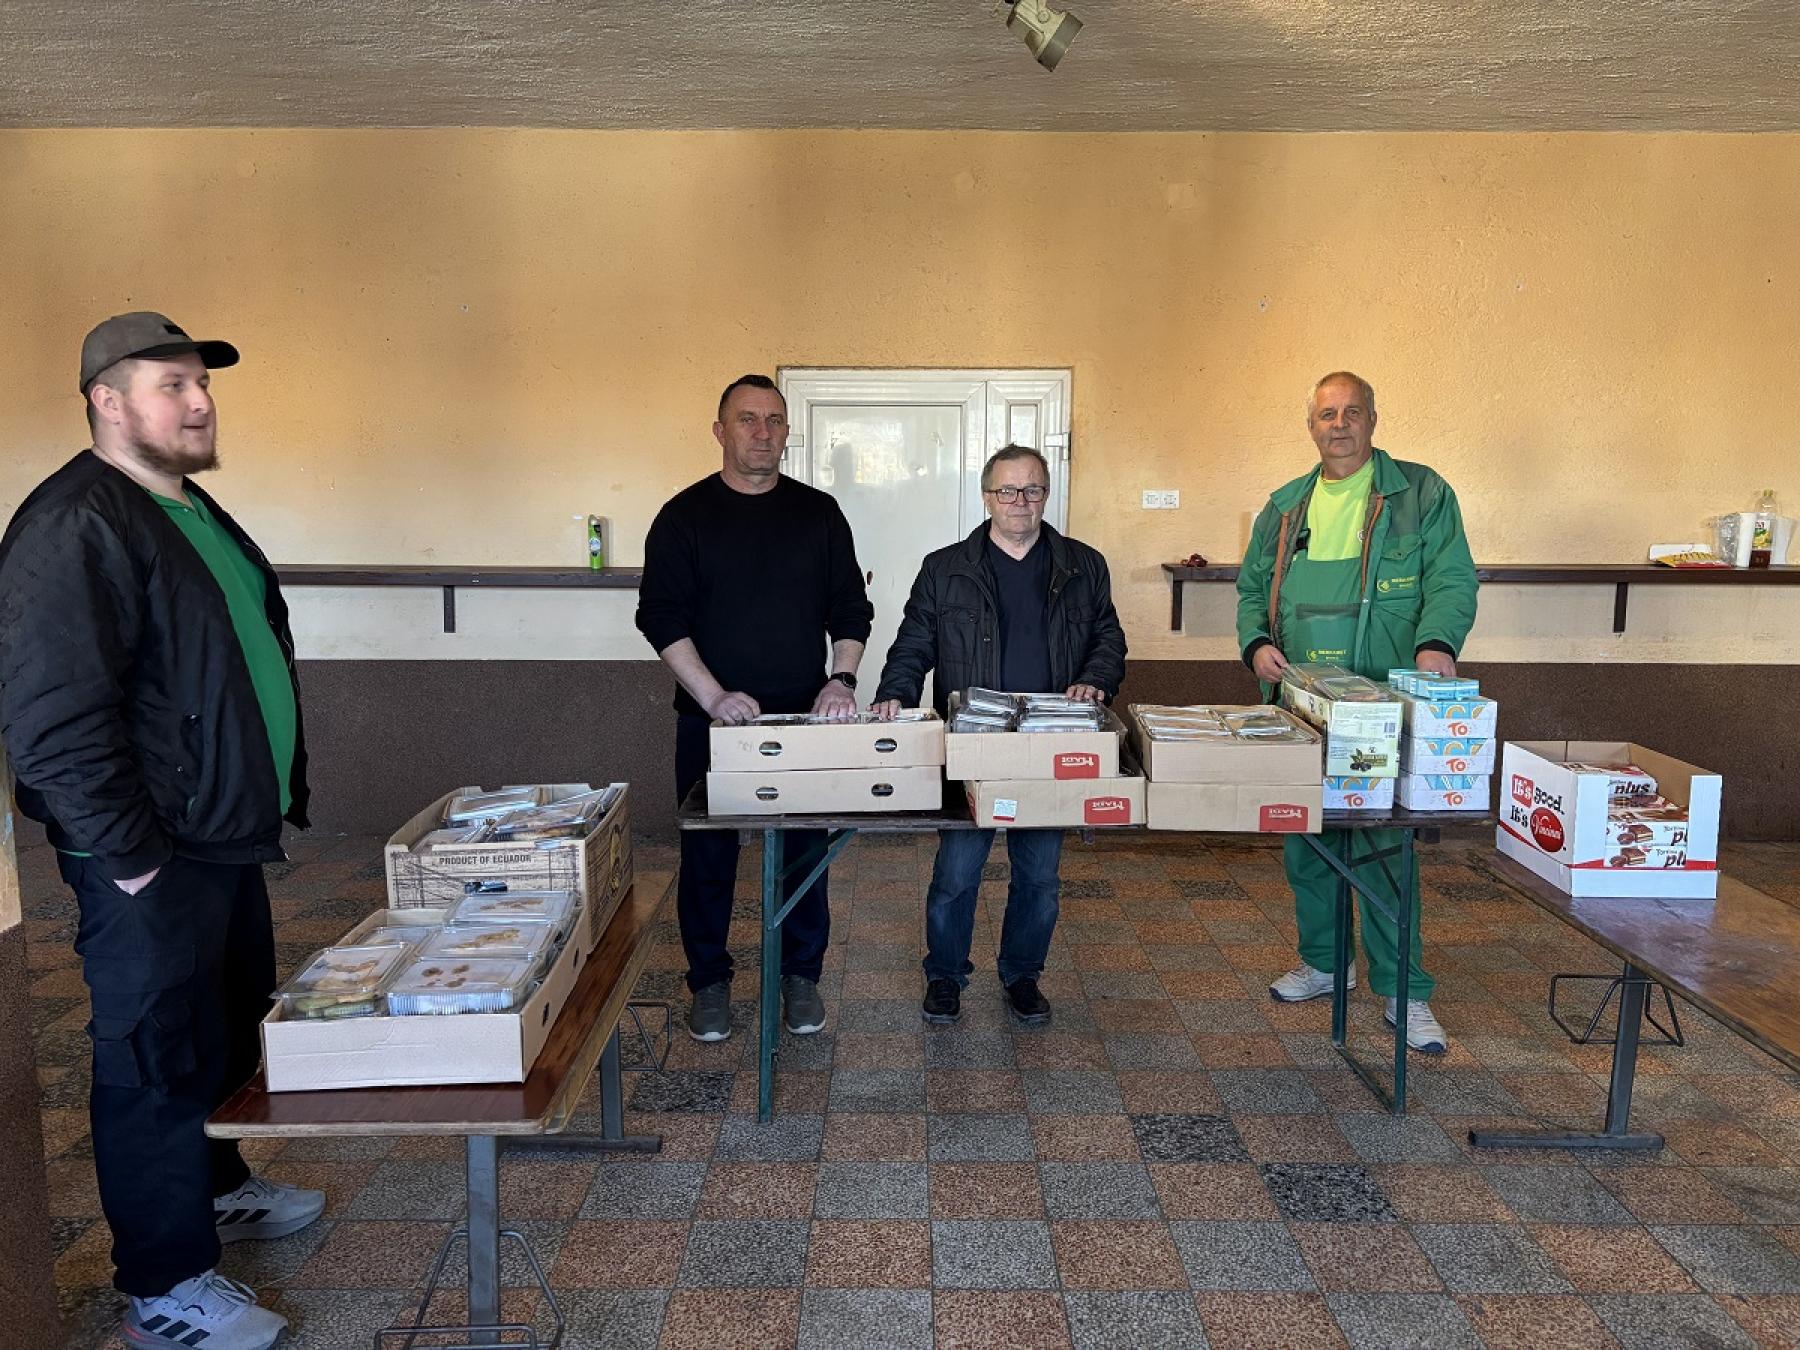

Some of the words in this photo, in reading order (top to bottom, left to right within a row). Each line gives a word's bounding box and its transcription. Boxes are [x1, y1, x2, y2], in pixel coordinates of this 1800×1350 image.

[1513, 778, 1532, 800] It's
[1510, 805, 1528, 828] It's
[439, 855, 478, 865] PRODUCT
[479, 855, 491, 865] OF
[493, 854, 533, 864] ECUADOR
